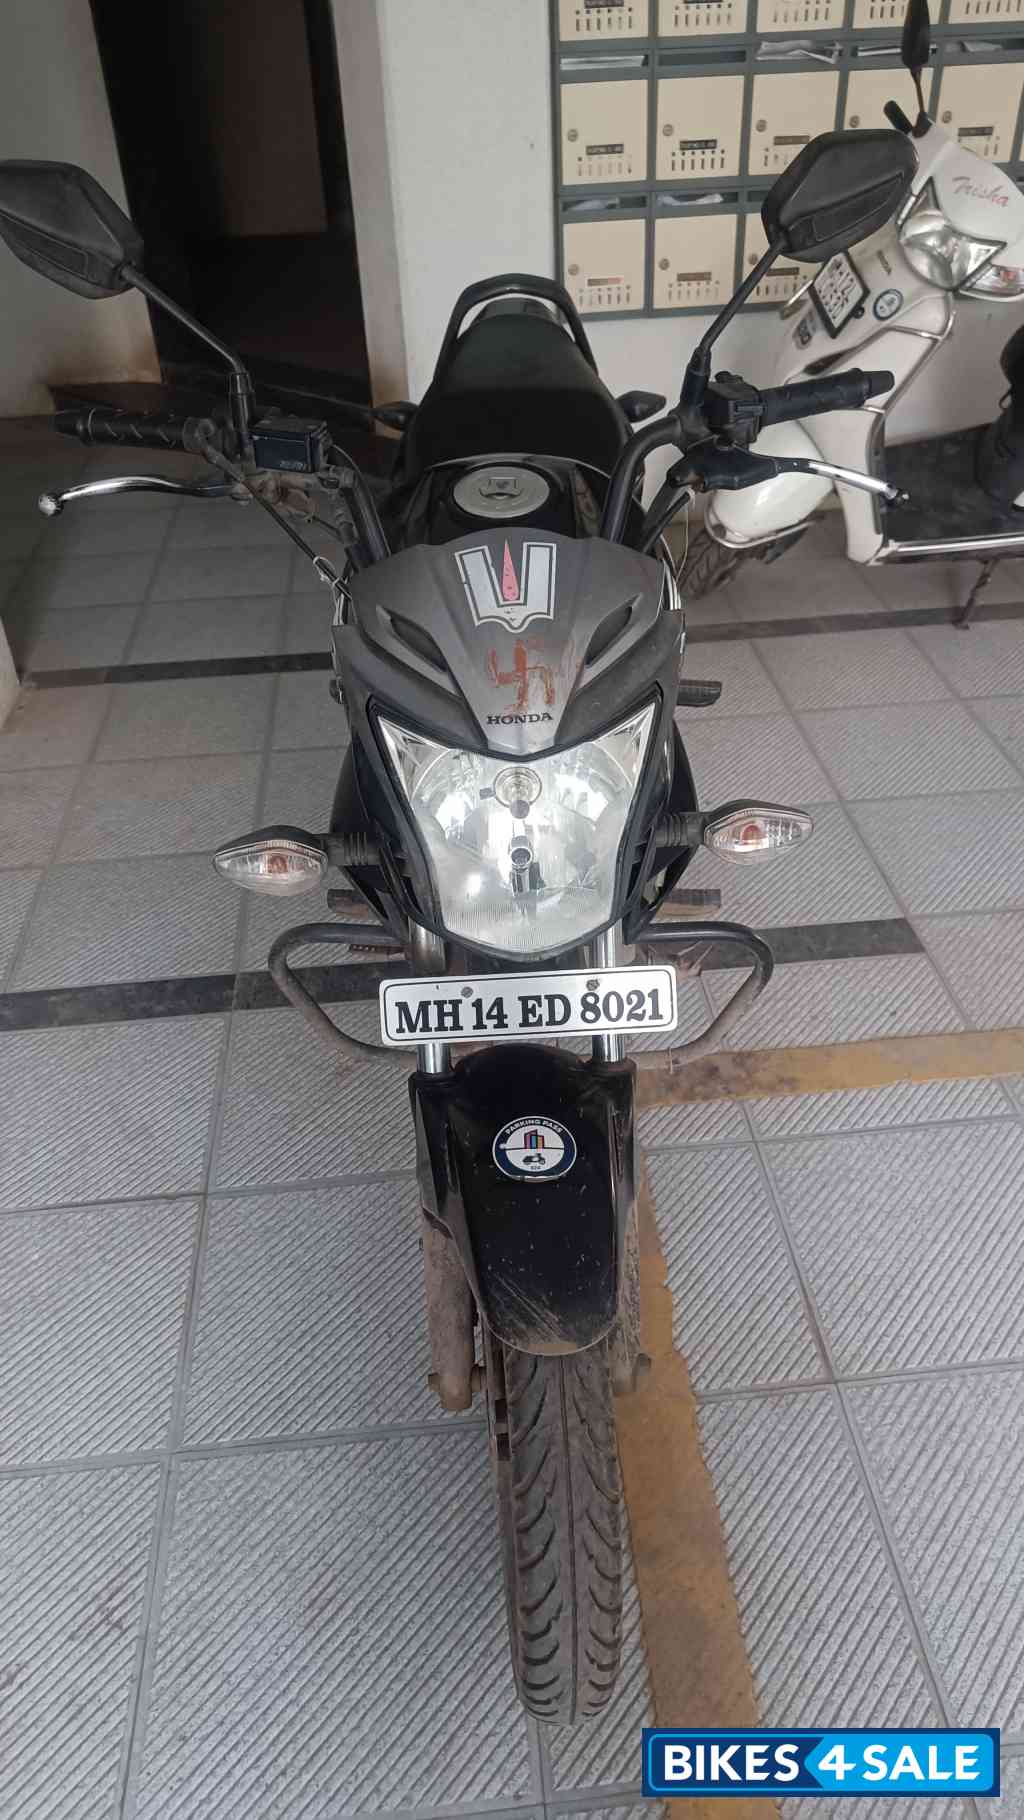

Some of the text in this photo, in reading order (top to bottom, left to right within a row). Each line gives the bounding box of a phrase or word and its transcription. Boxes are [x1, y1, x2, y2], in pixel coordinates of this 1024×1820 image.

[487, 712, 553, 724] HONDA
[395, 989, 663, 1033] MH 14 ED 8021
[505, 1119, 563, 1135] PARKING PASS
